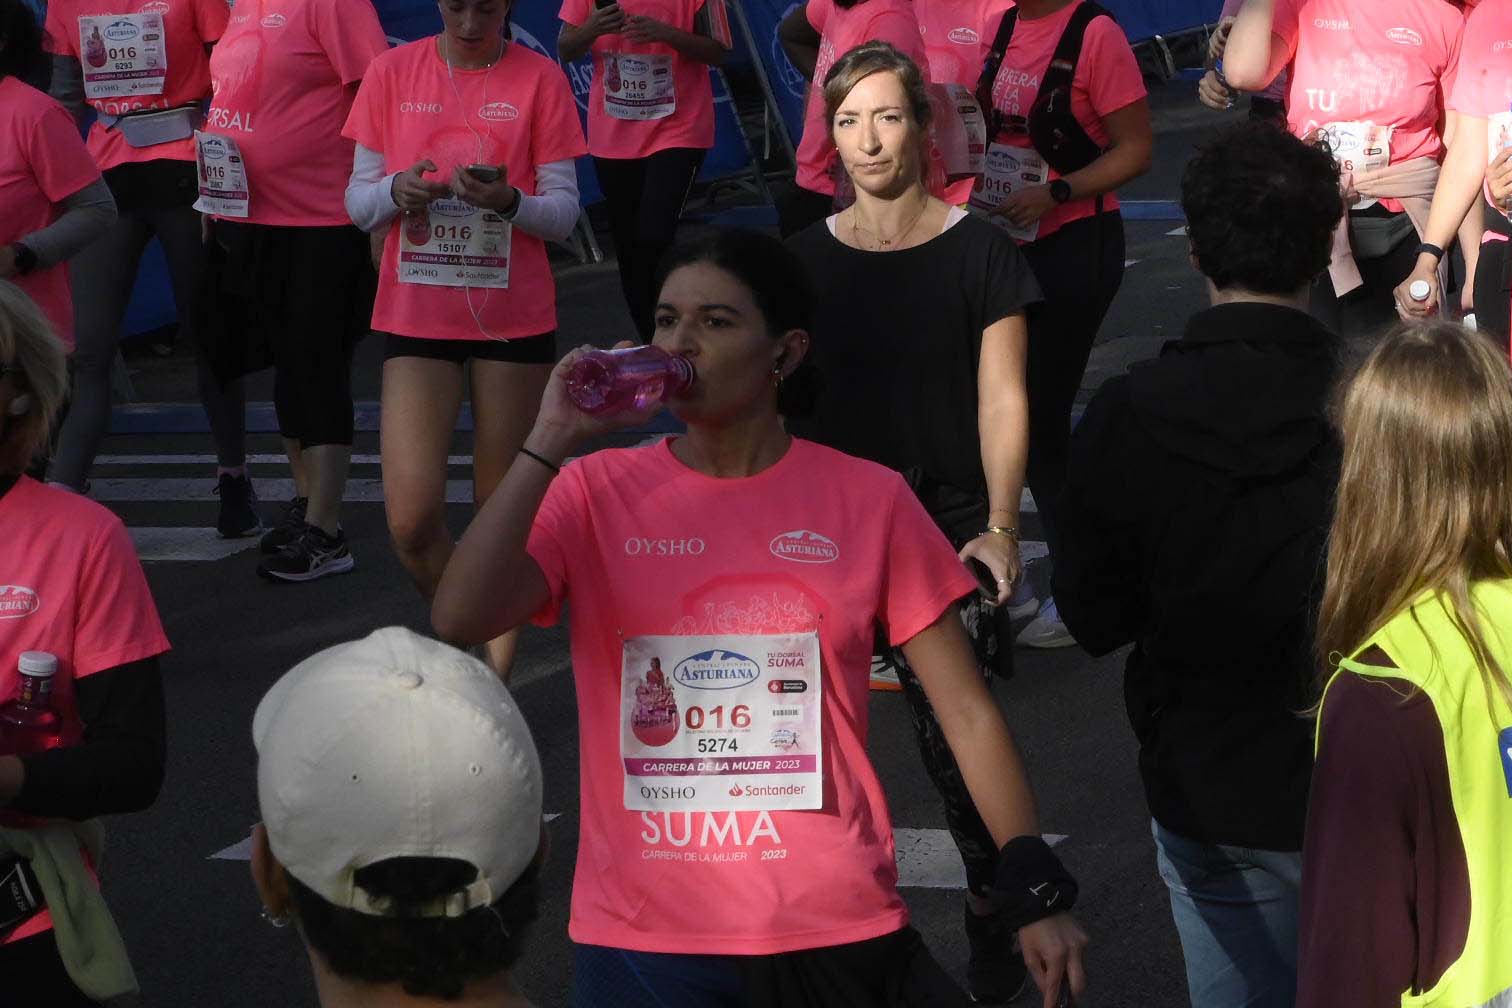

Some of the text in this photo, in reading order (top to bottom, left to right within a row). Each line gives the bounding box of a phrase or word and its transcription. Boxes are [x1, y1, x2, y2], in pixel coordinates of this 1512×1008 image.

[108, 46, 138, 60] 016
[115, 61, 134, 70] 6293
[622, 80, 648, 90] 016
[1305, 88, 1336, 112] TU
[400, 102, 442, 114] OYSHO
[985, 176, 1012, 195] 016
[434, 225, 472, 241] 016
[624, 537, 706, 556] OYSHO
[775, 541, 835, 559] ASTURIANA
[767, 658, 805, 668] SUMA
[680, 666, 754, 681] ASTURIANA
[685, 705, 752, 730] 016
[698, 738, 739, 753] 5274
[643, 759, 801, 773] CARRERA DE LA MUJER 2023
[640, 786, 697, 800] OYSHO
[745, 783, 806, 797] Santander
[640, 811, 782, 848] SUMA
[641, 849, 683, 861] CARRERA
[684, 851, 697, 862] DE
[711, 851, 748, 863] MUJER
[761, 849, 787, 860] 2023
